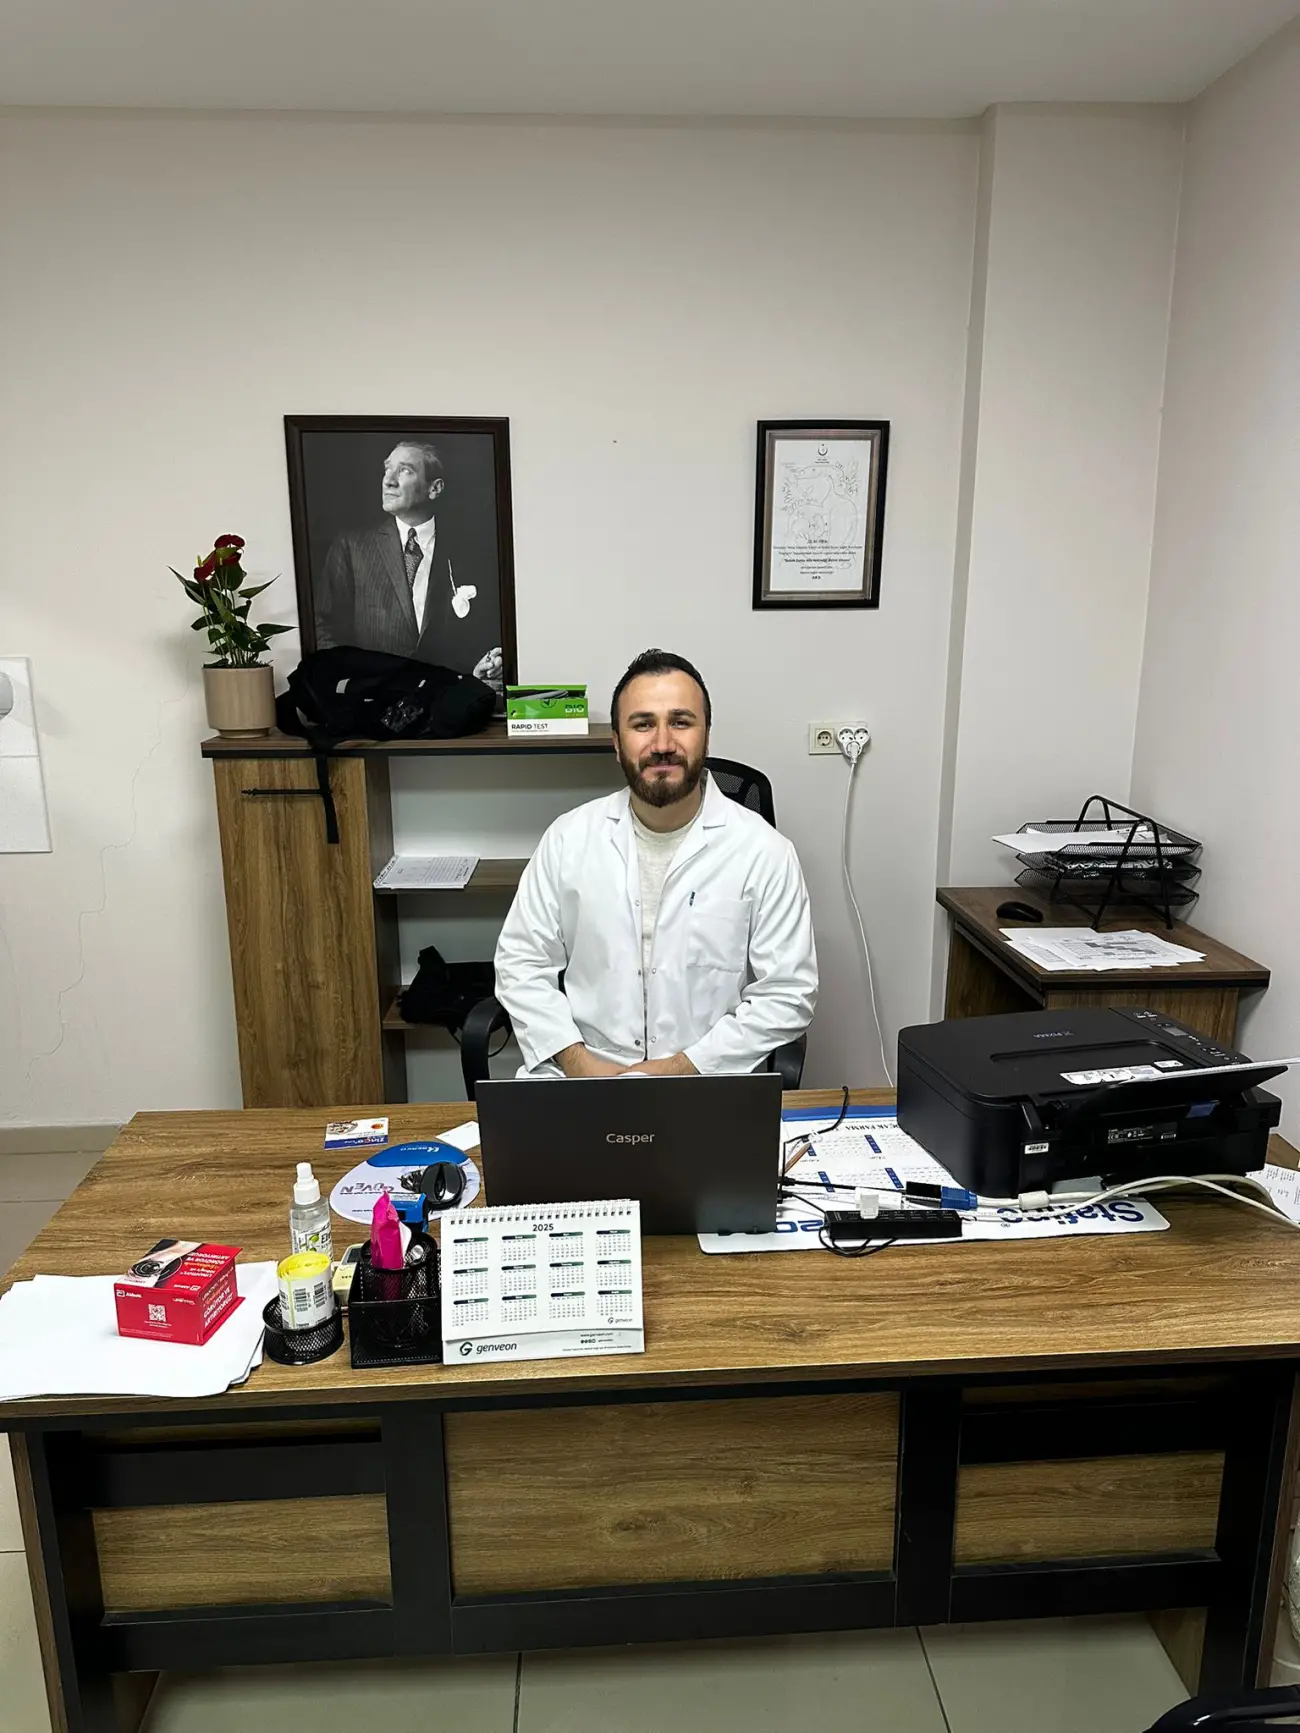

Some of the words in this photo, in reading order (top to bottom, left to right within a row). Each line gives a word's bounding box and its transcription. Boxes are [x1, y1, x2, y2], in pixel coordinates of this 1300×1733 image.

[606, 1133, 655, 1146] Casper
[532, 1223, 554, 1232] 2025
[476, 1342, 517, 1354] genveon
